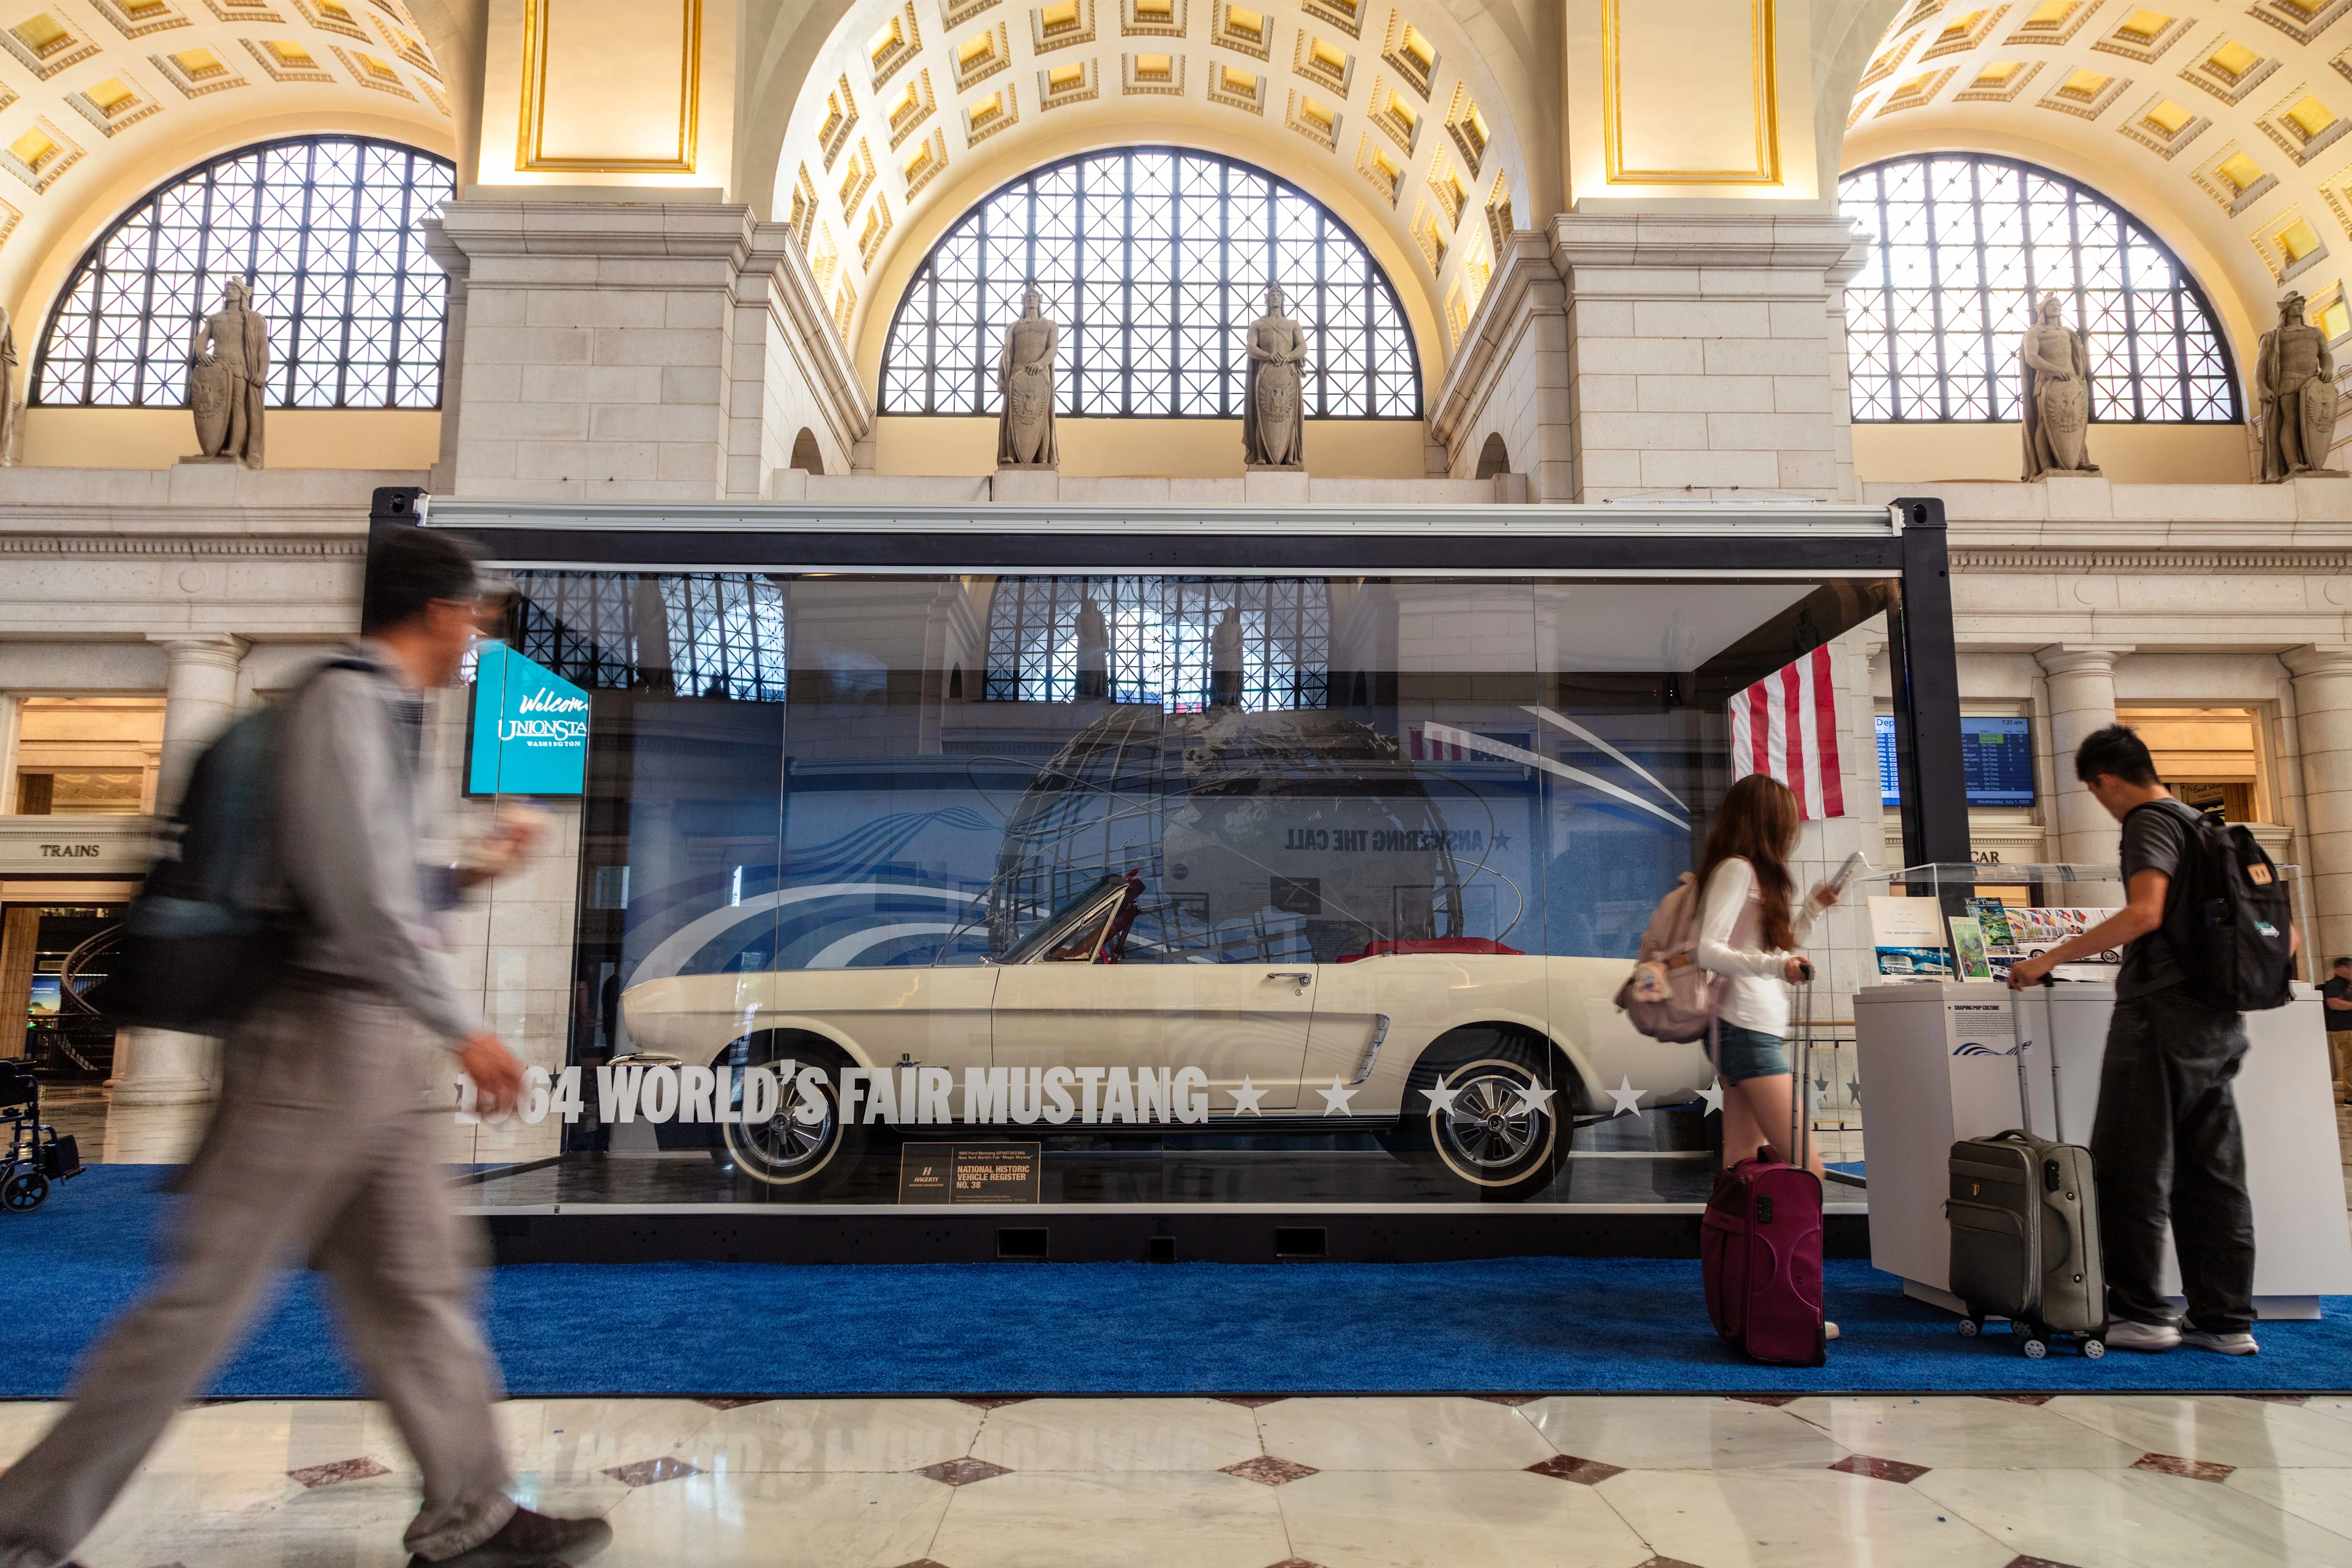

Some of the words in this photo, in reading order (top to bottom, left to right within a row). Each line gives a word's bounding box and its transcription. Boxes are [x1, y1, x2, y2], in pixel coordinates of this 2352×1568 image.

[2193, 785, 2207, 793] East
[40, 845, 100, 858] TRAINS
[1970, 851, 2000, 863] CAR
[839, 1067, 953, 1125] FAIR
[963, 1066, 1208, 1125] MUSTANG
